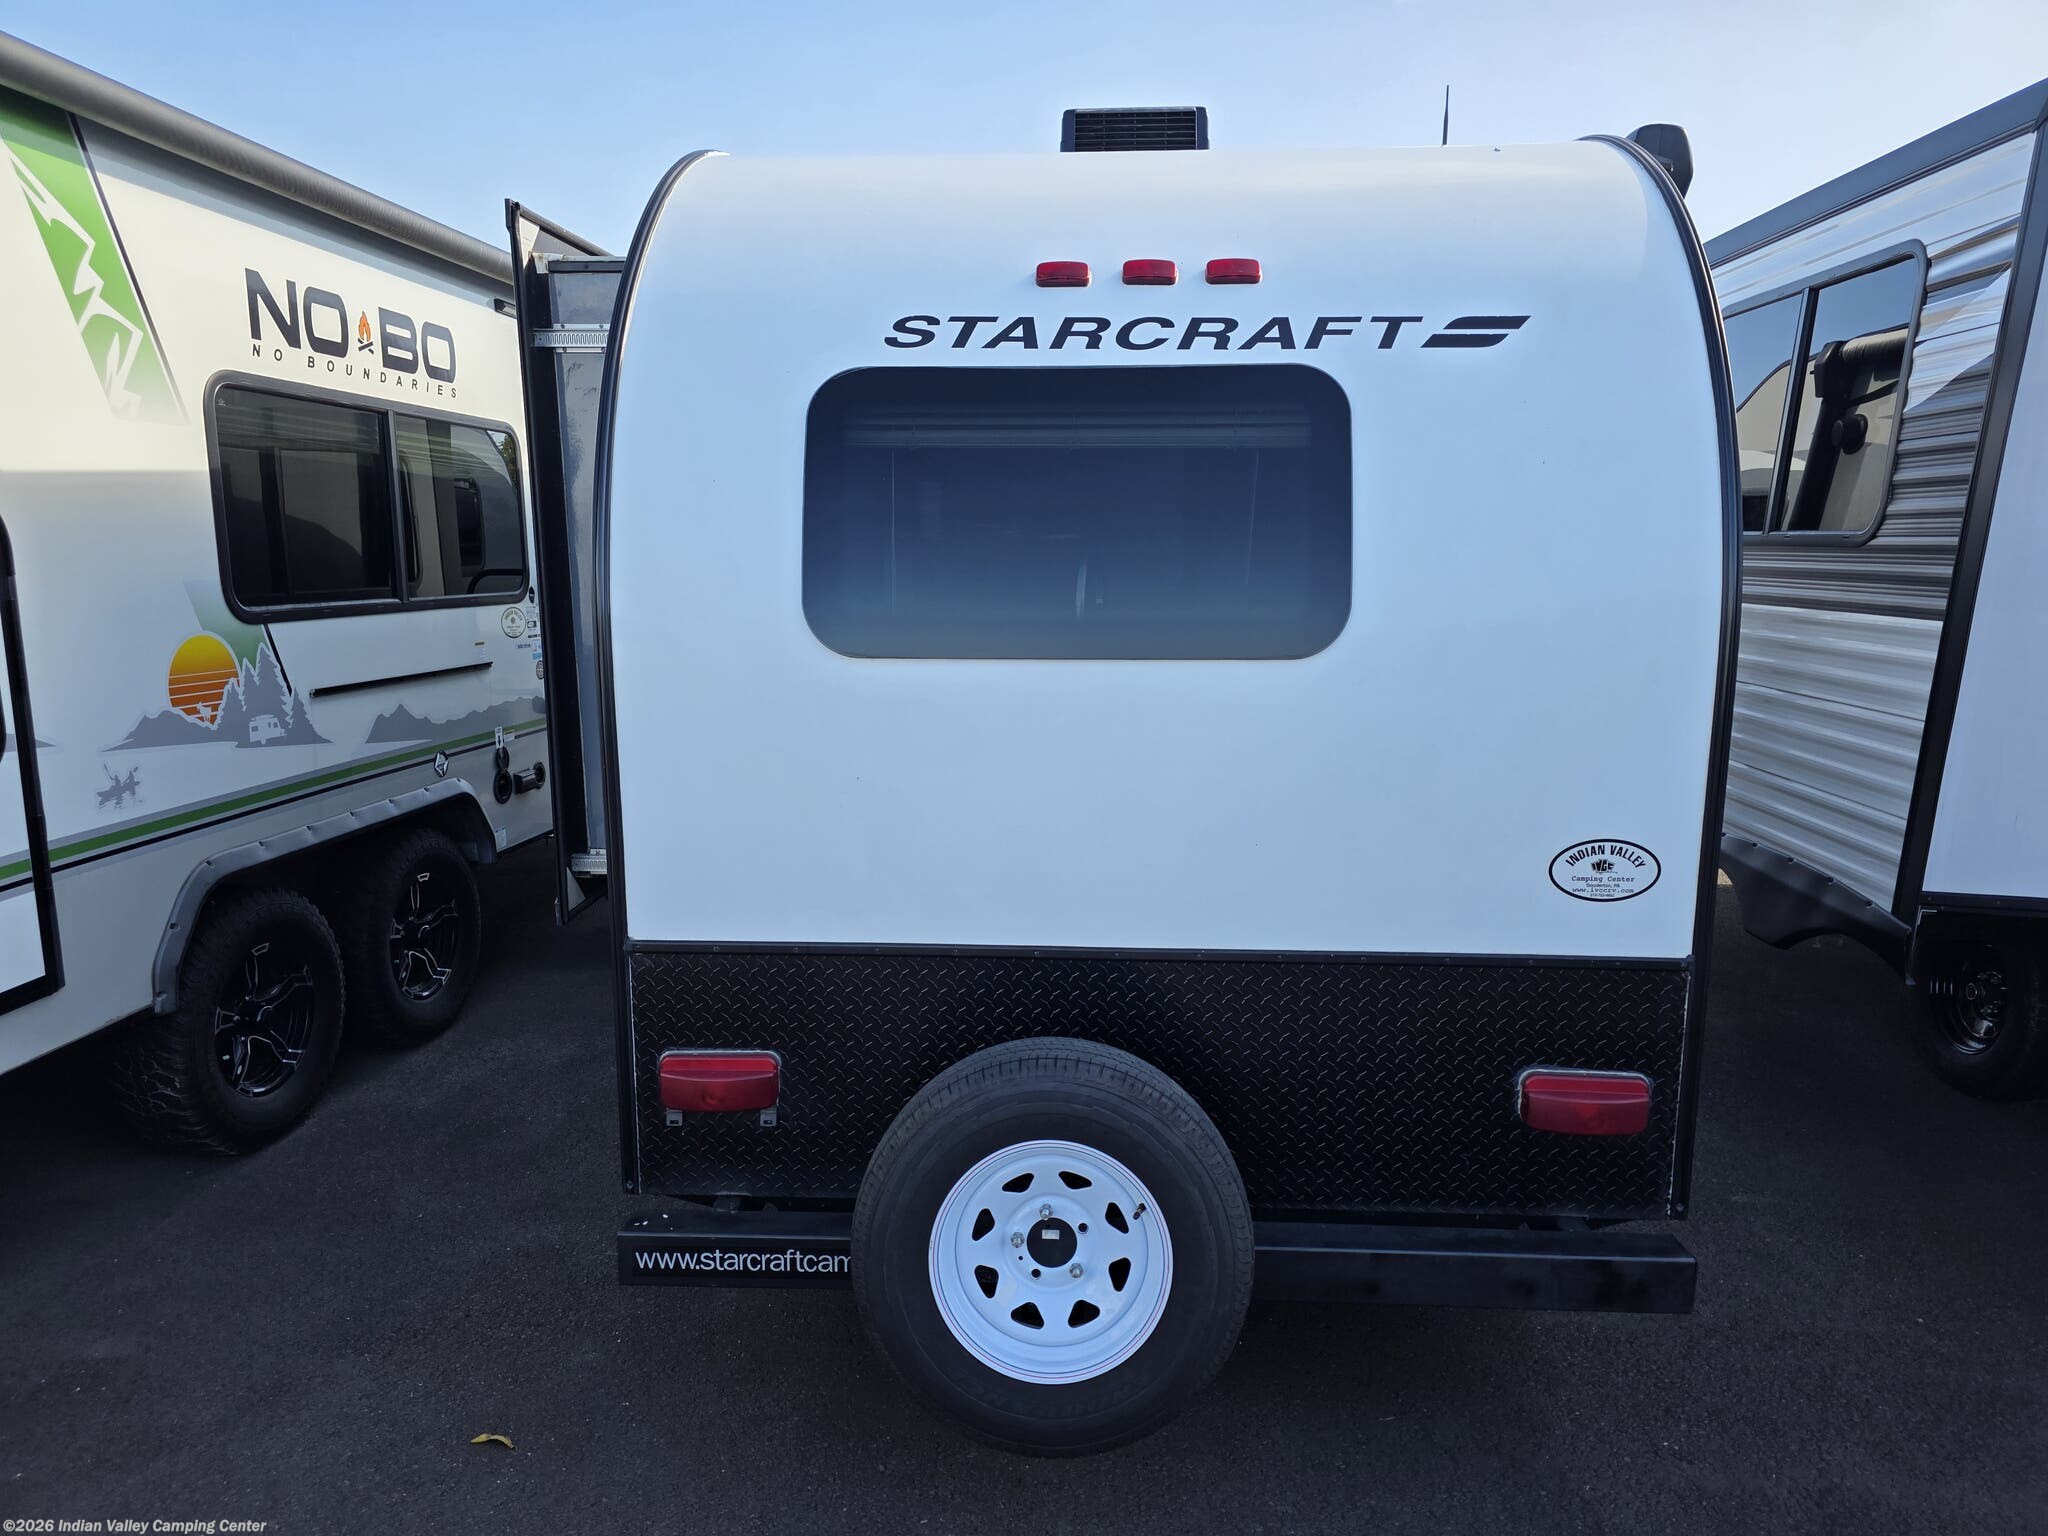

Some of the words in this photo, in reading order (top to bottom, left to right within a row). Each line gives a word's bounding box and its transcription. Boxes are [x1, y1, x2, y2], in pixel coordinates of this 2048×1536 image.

[884, 315, 1422, 350] STARCRAFT
[252, 343, 283, 362] NO
[307, 355, 457, 398] BOUNDARIES
[1565, 844, 1605, 867] INDIAN
[1610, 845, 1646, 868] VALLEY
[1571, 875, 1603, 883] Camping
